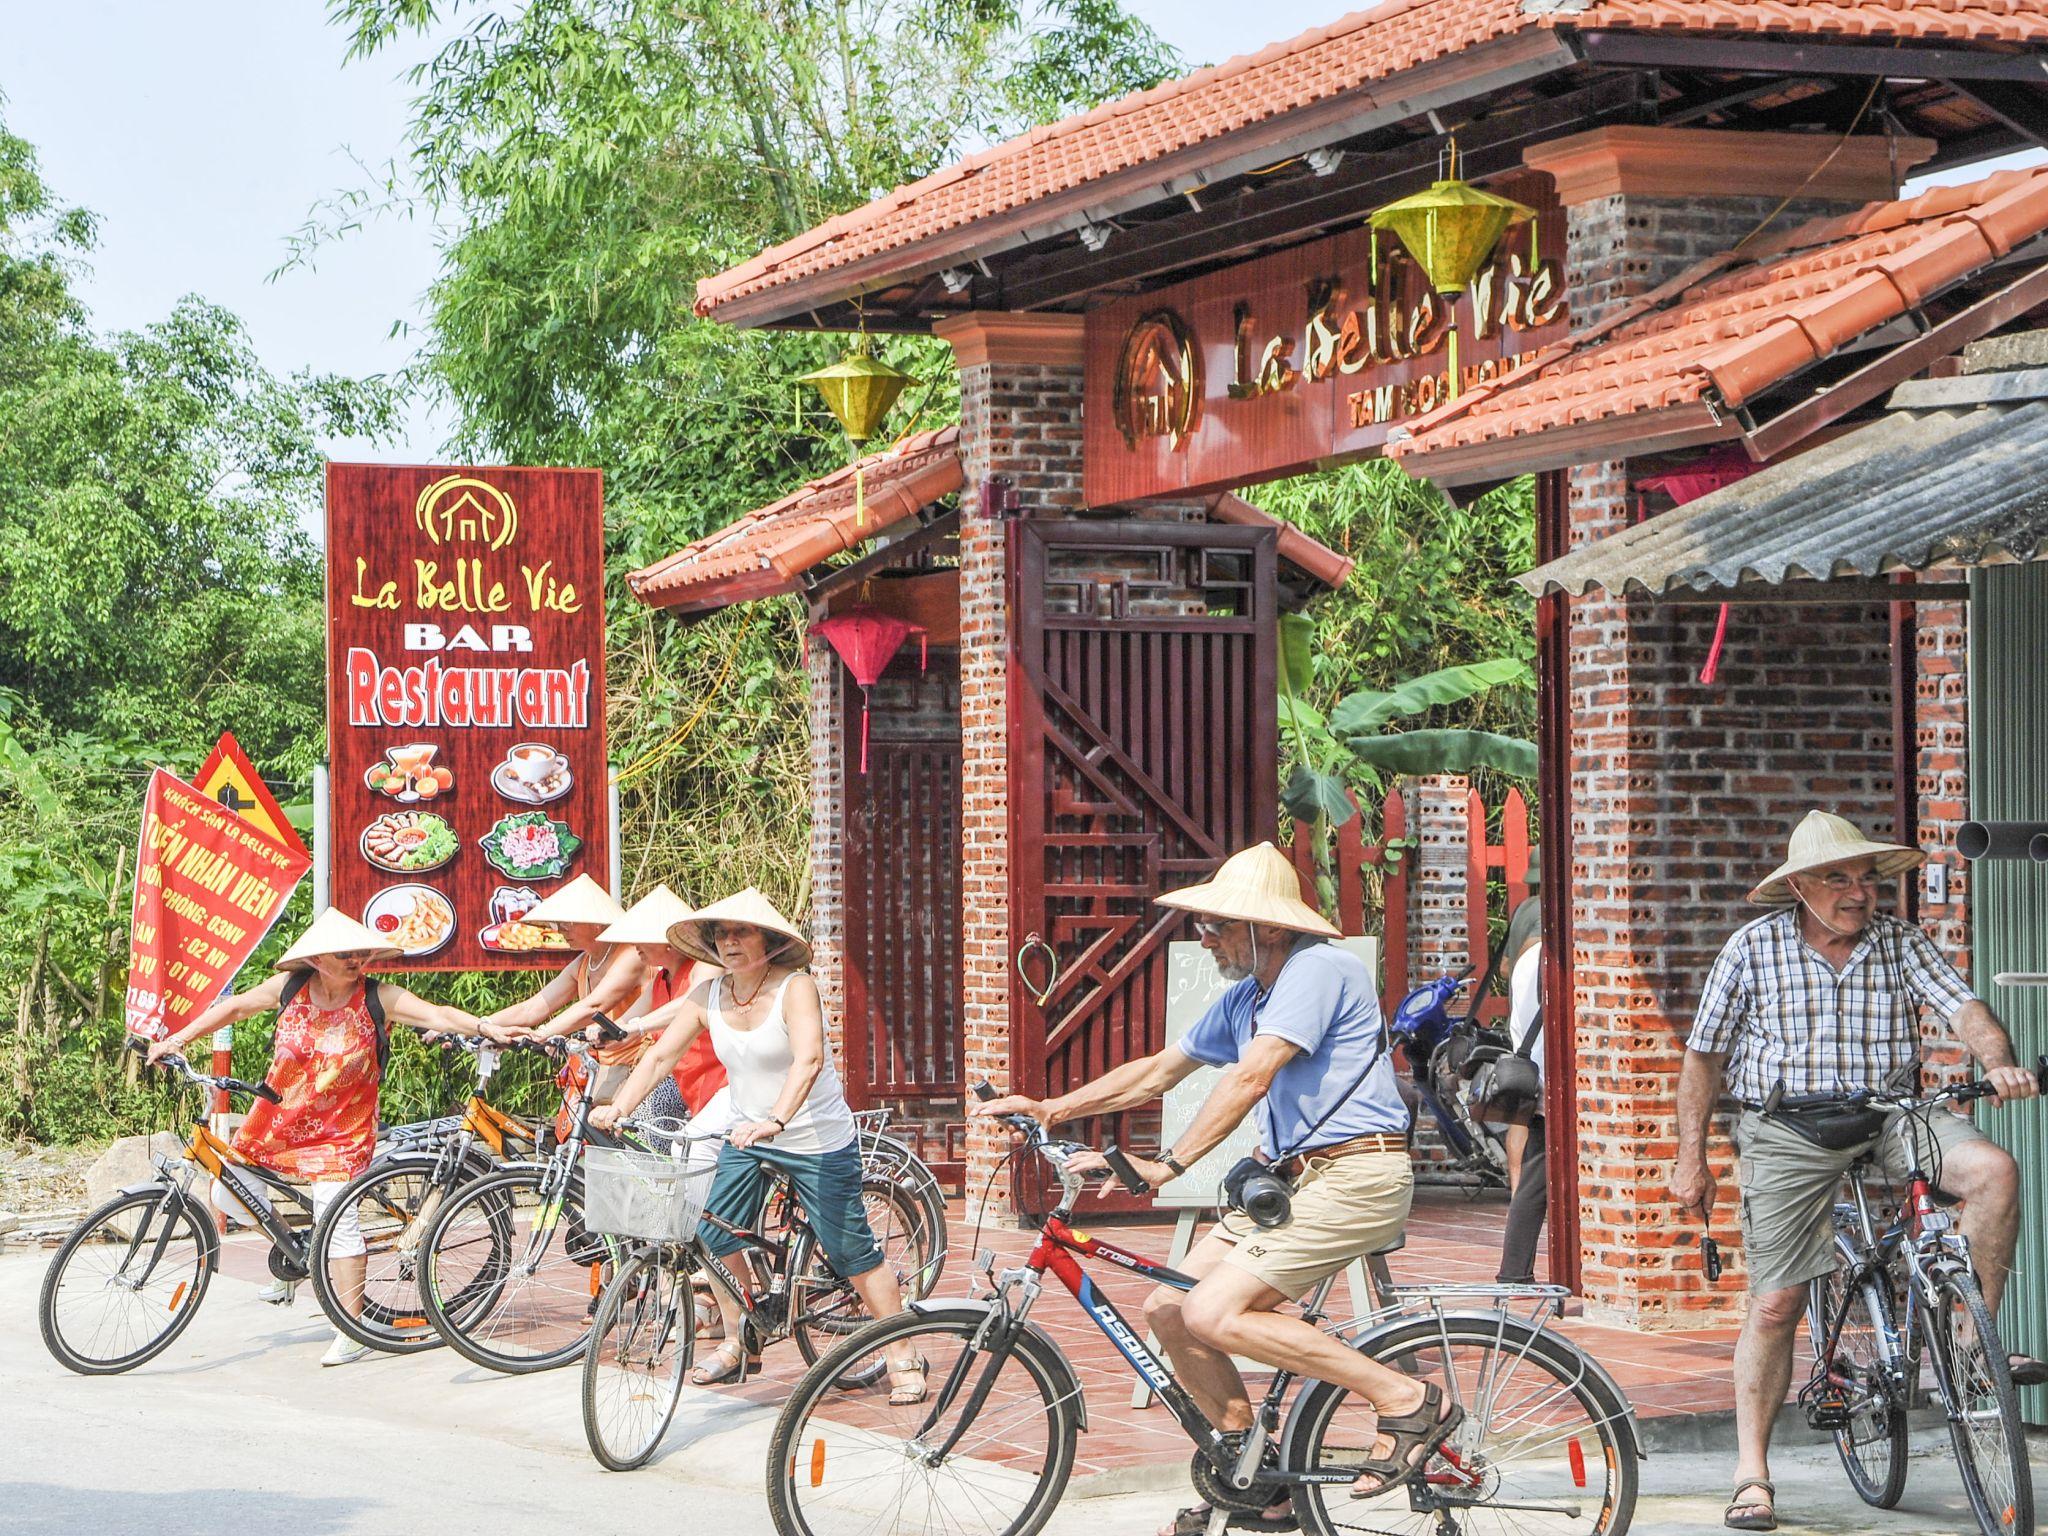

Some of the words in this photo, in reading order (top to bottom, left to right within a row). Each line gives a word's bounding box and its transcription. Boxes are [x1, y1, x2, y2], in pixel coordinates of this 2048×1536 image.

[1470, 254, 1566, 341] Vie
[1347, 384, 1395, 428] TAM
[351, 557, 401, 611] La
[415, 558, 511, 613] Belle
[521, 560, 582, 614] Vie
[404, 623, 533, 652] BAR
[346, 647, 590, 728] Restaurant
[163, 787, 201, 816] KHÁCH
[199, 809, 226, 830] SẠN
[239, 833, 272, 858] BELLE
[271, 851, 291, 870] VIE
[175, 842, 239, 896] NHÂN
[228, 871, 279, 920] VIÊN
[206, 915, 246, 945] 03NV
[186, 937, 209, 959] 02
[204, 947, 230, 970] NV
[169, 961, 190, 982] 01
[186, 970, 212, 992] NV
[169, 994, 194, 1016] NV
[709, 1252, 745, 1294] VENTANA
